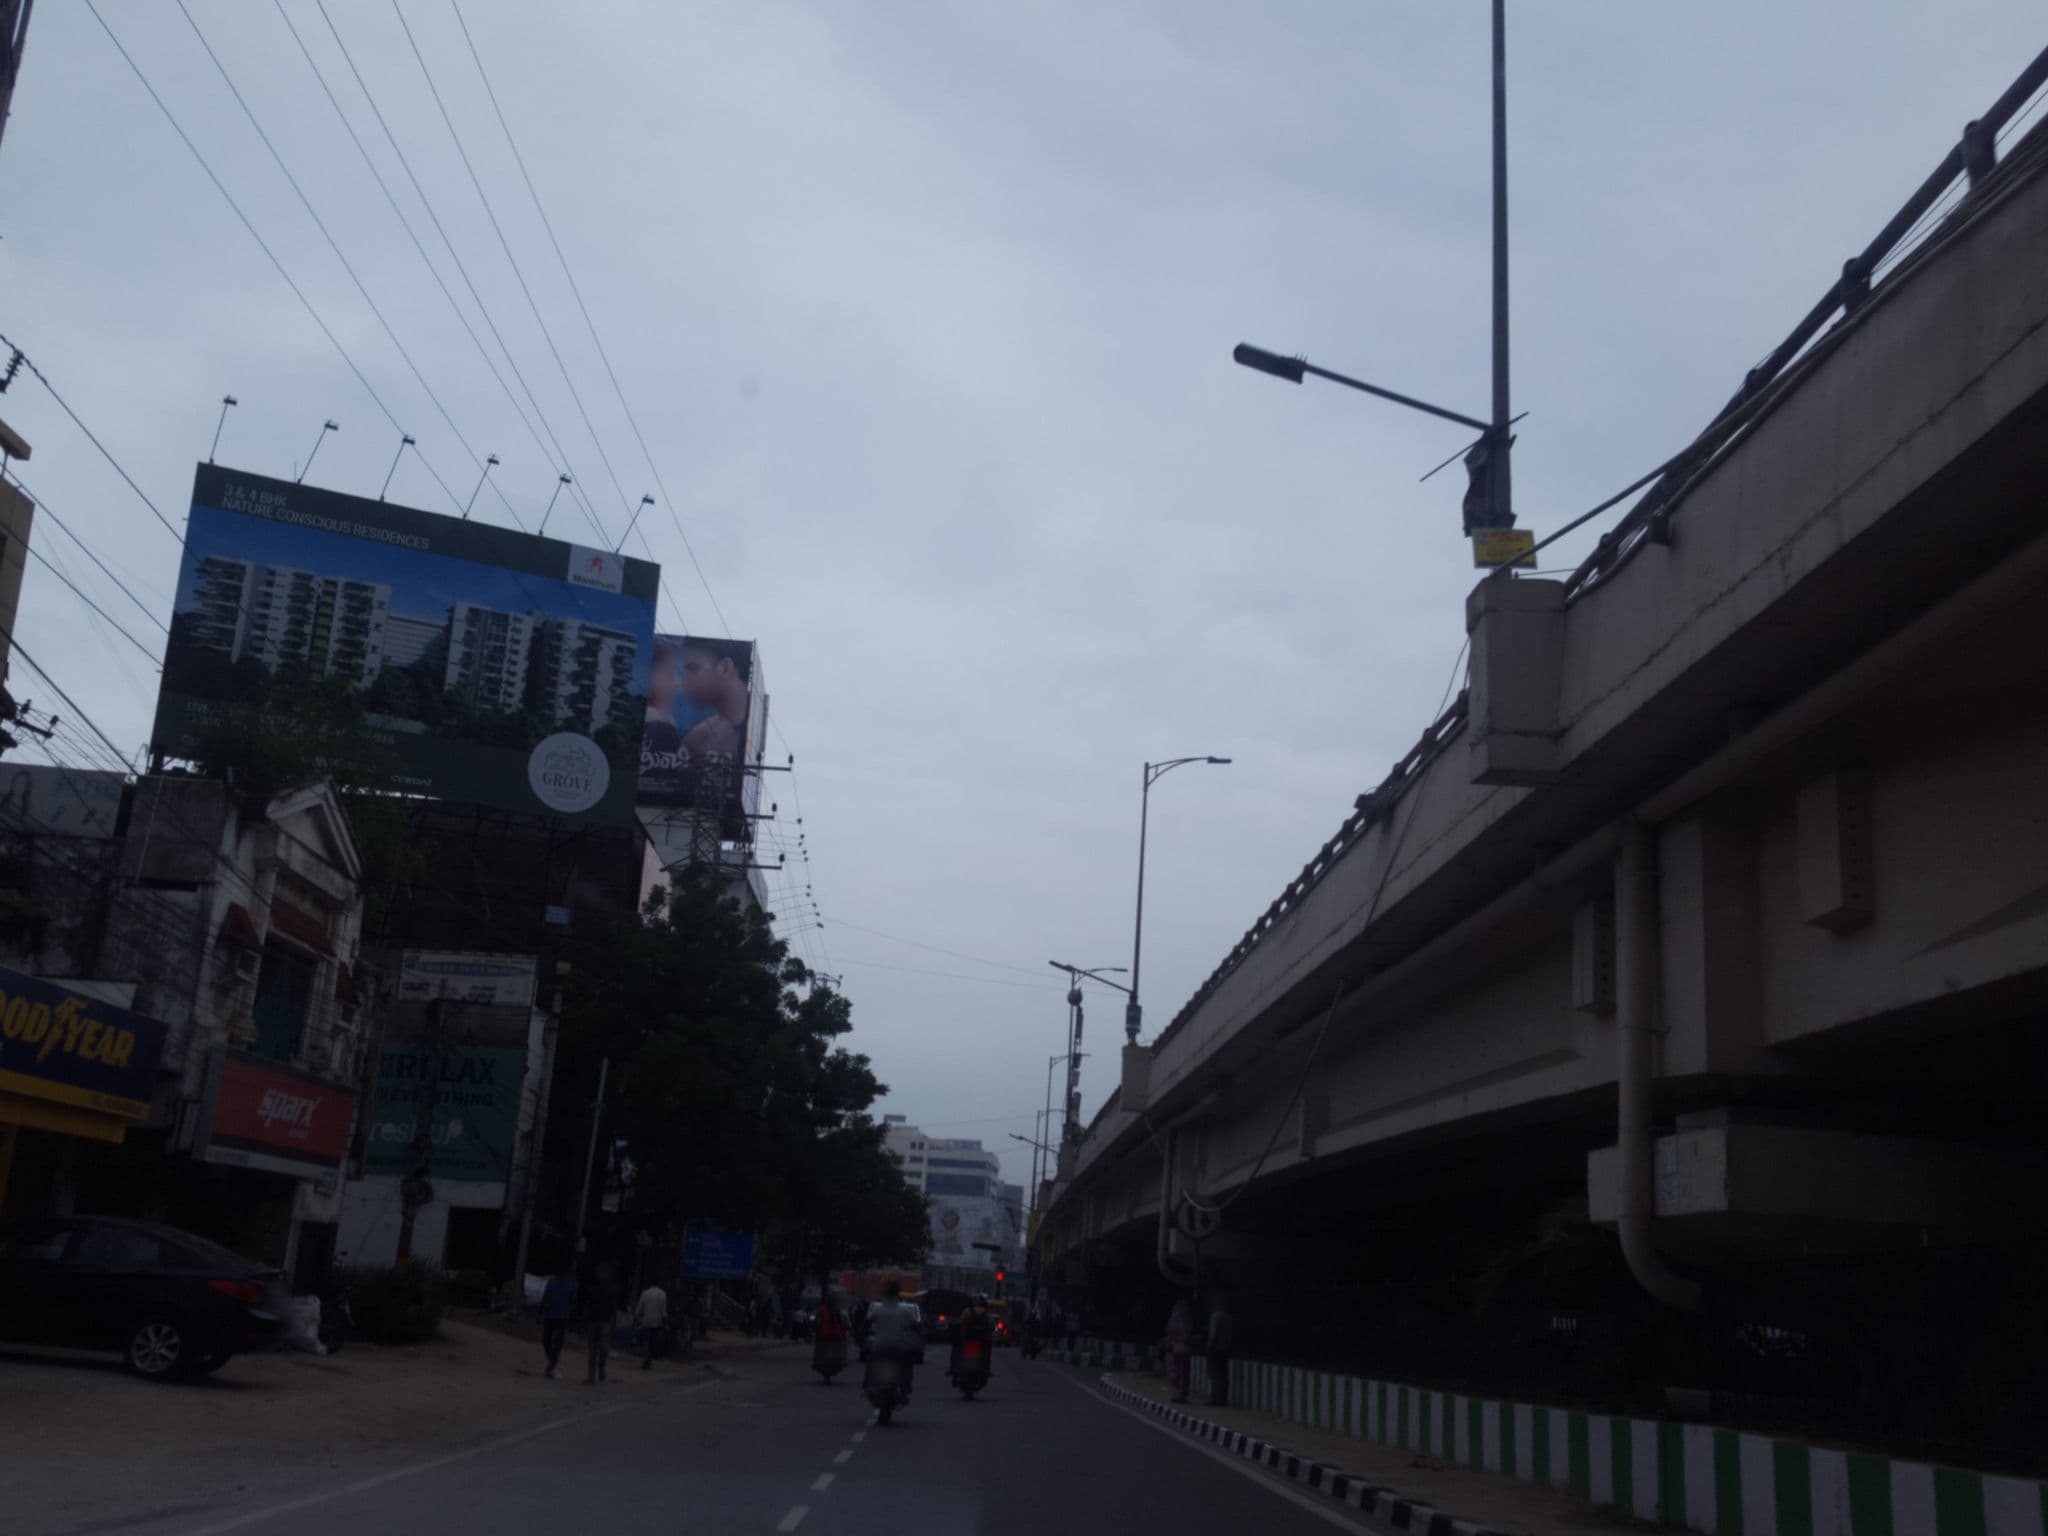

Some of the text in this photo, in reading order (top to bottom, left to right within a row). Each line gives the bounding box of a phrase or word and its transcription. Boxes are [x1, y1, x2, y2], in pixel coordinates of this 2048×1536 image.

[224, 483, 233, 496] 3
[260, 491, 288, 506] BHK
[221, 495, 431, 549] NATURE CONSCIOUS RESIDENCES
[543, 771, 593, 793] GROVE
